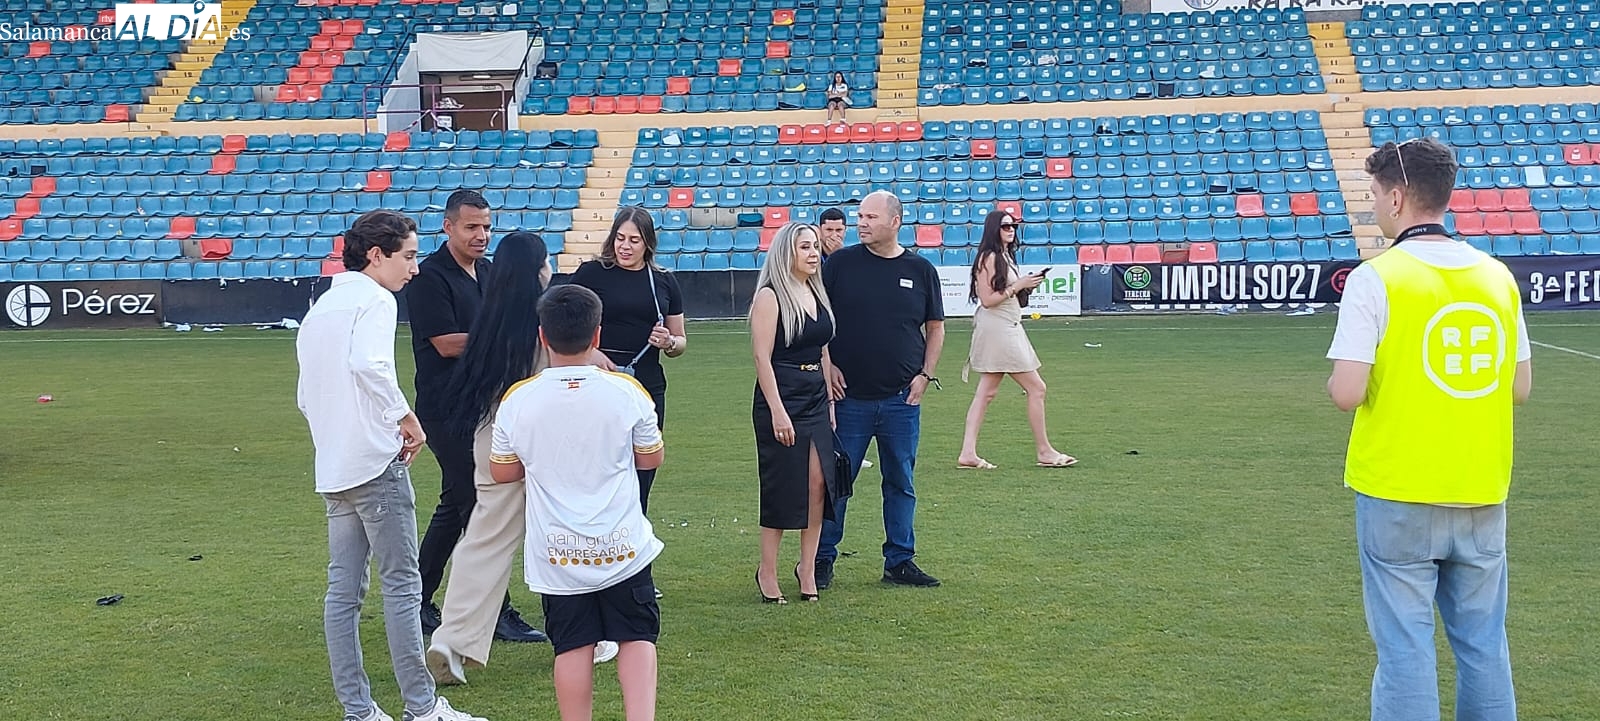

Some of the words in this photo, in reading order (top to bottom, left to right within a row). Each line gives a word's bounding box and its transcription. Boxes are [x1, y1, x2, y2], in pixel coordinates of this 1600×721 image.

[1161, 264, 1321, 301] IMPULSO27
[62, 288, 156, 316] Pérez
[547, 533, 580, 546] nani
[585, 527, 630, 550] grupo
[547, 542, 634, 559] EMPRESARIAL
